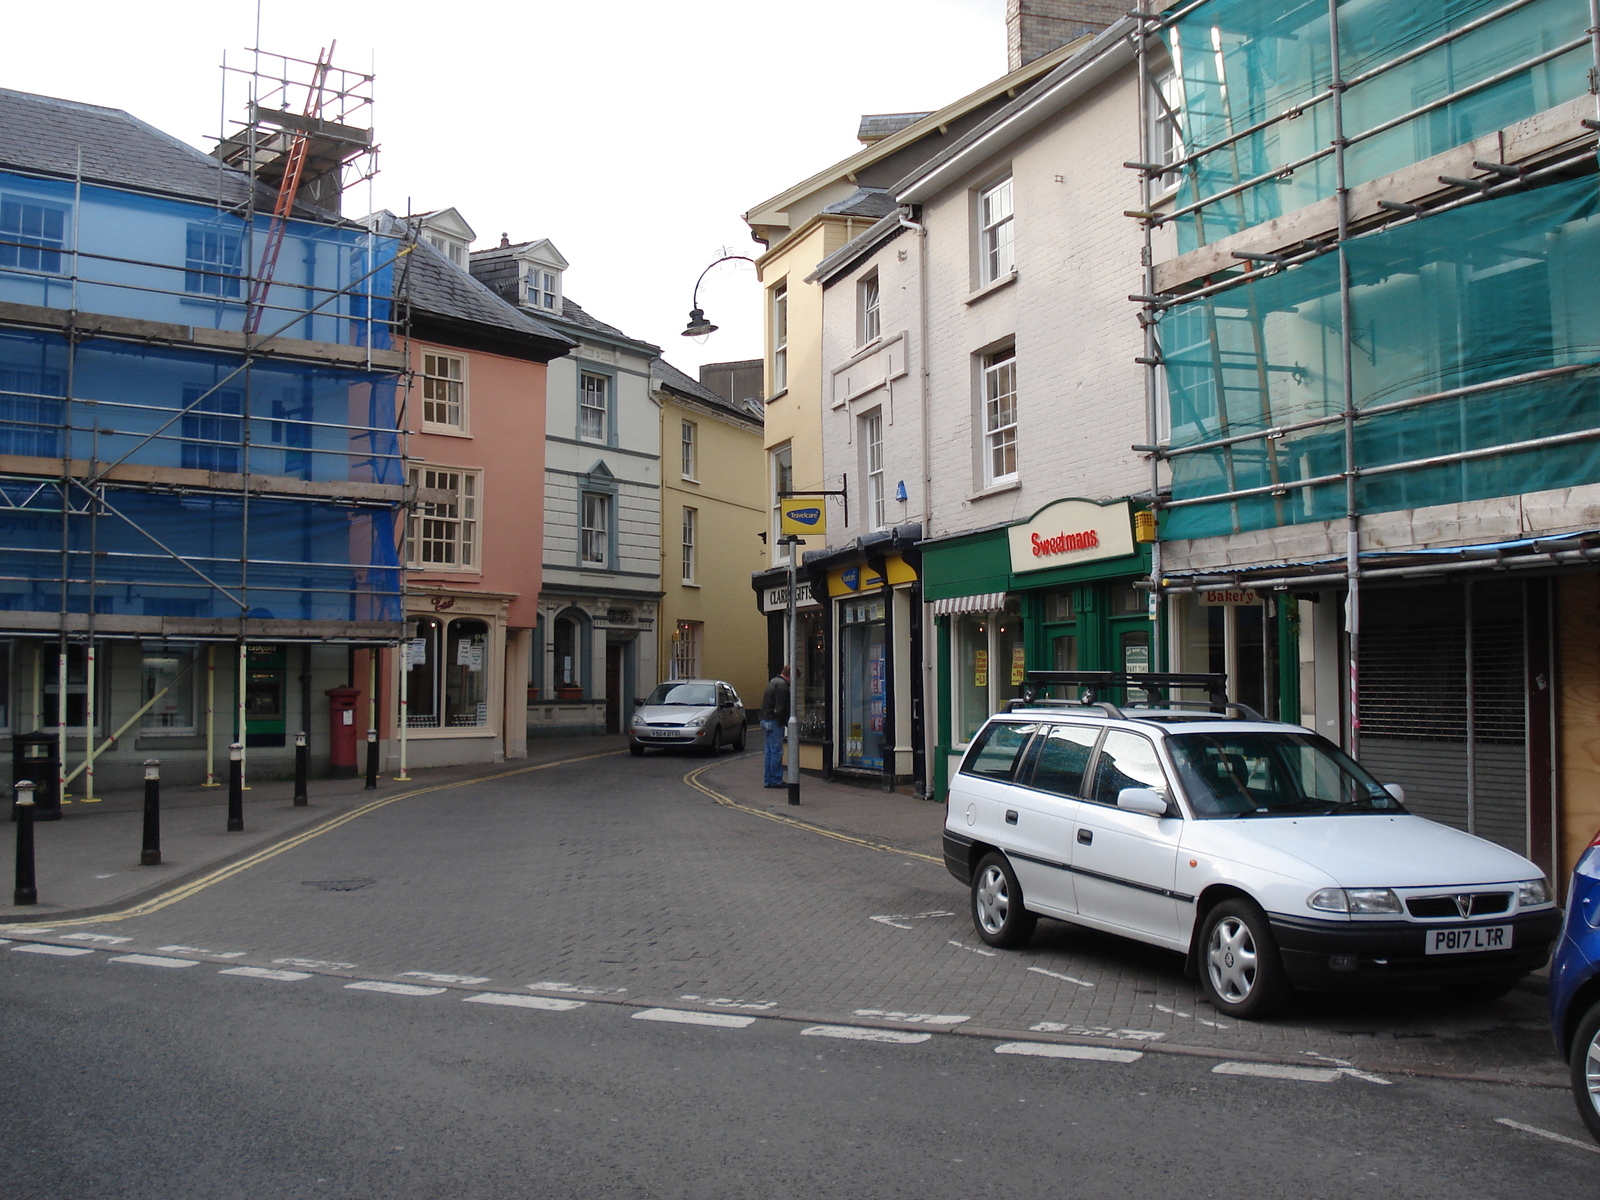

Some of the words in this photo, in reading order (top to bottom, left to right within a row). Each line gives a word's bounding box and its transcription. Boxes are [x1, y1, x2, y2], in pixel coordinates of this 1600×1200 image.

[1031, 529, 1099, 557] Sweetmans
[795, 584, 812, 601] GIFTS
[1207, 589, 1254, 604] Bakery
[1435, 930, 1472, 950] P817
[1474, 927, 1504, 947] LTR
